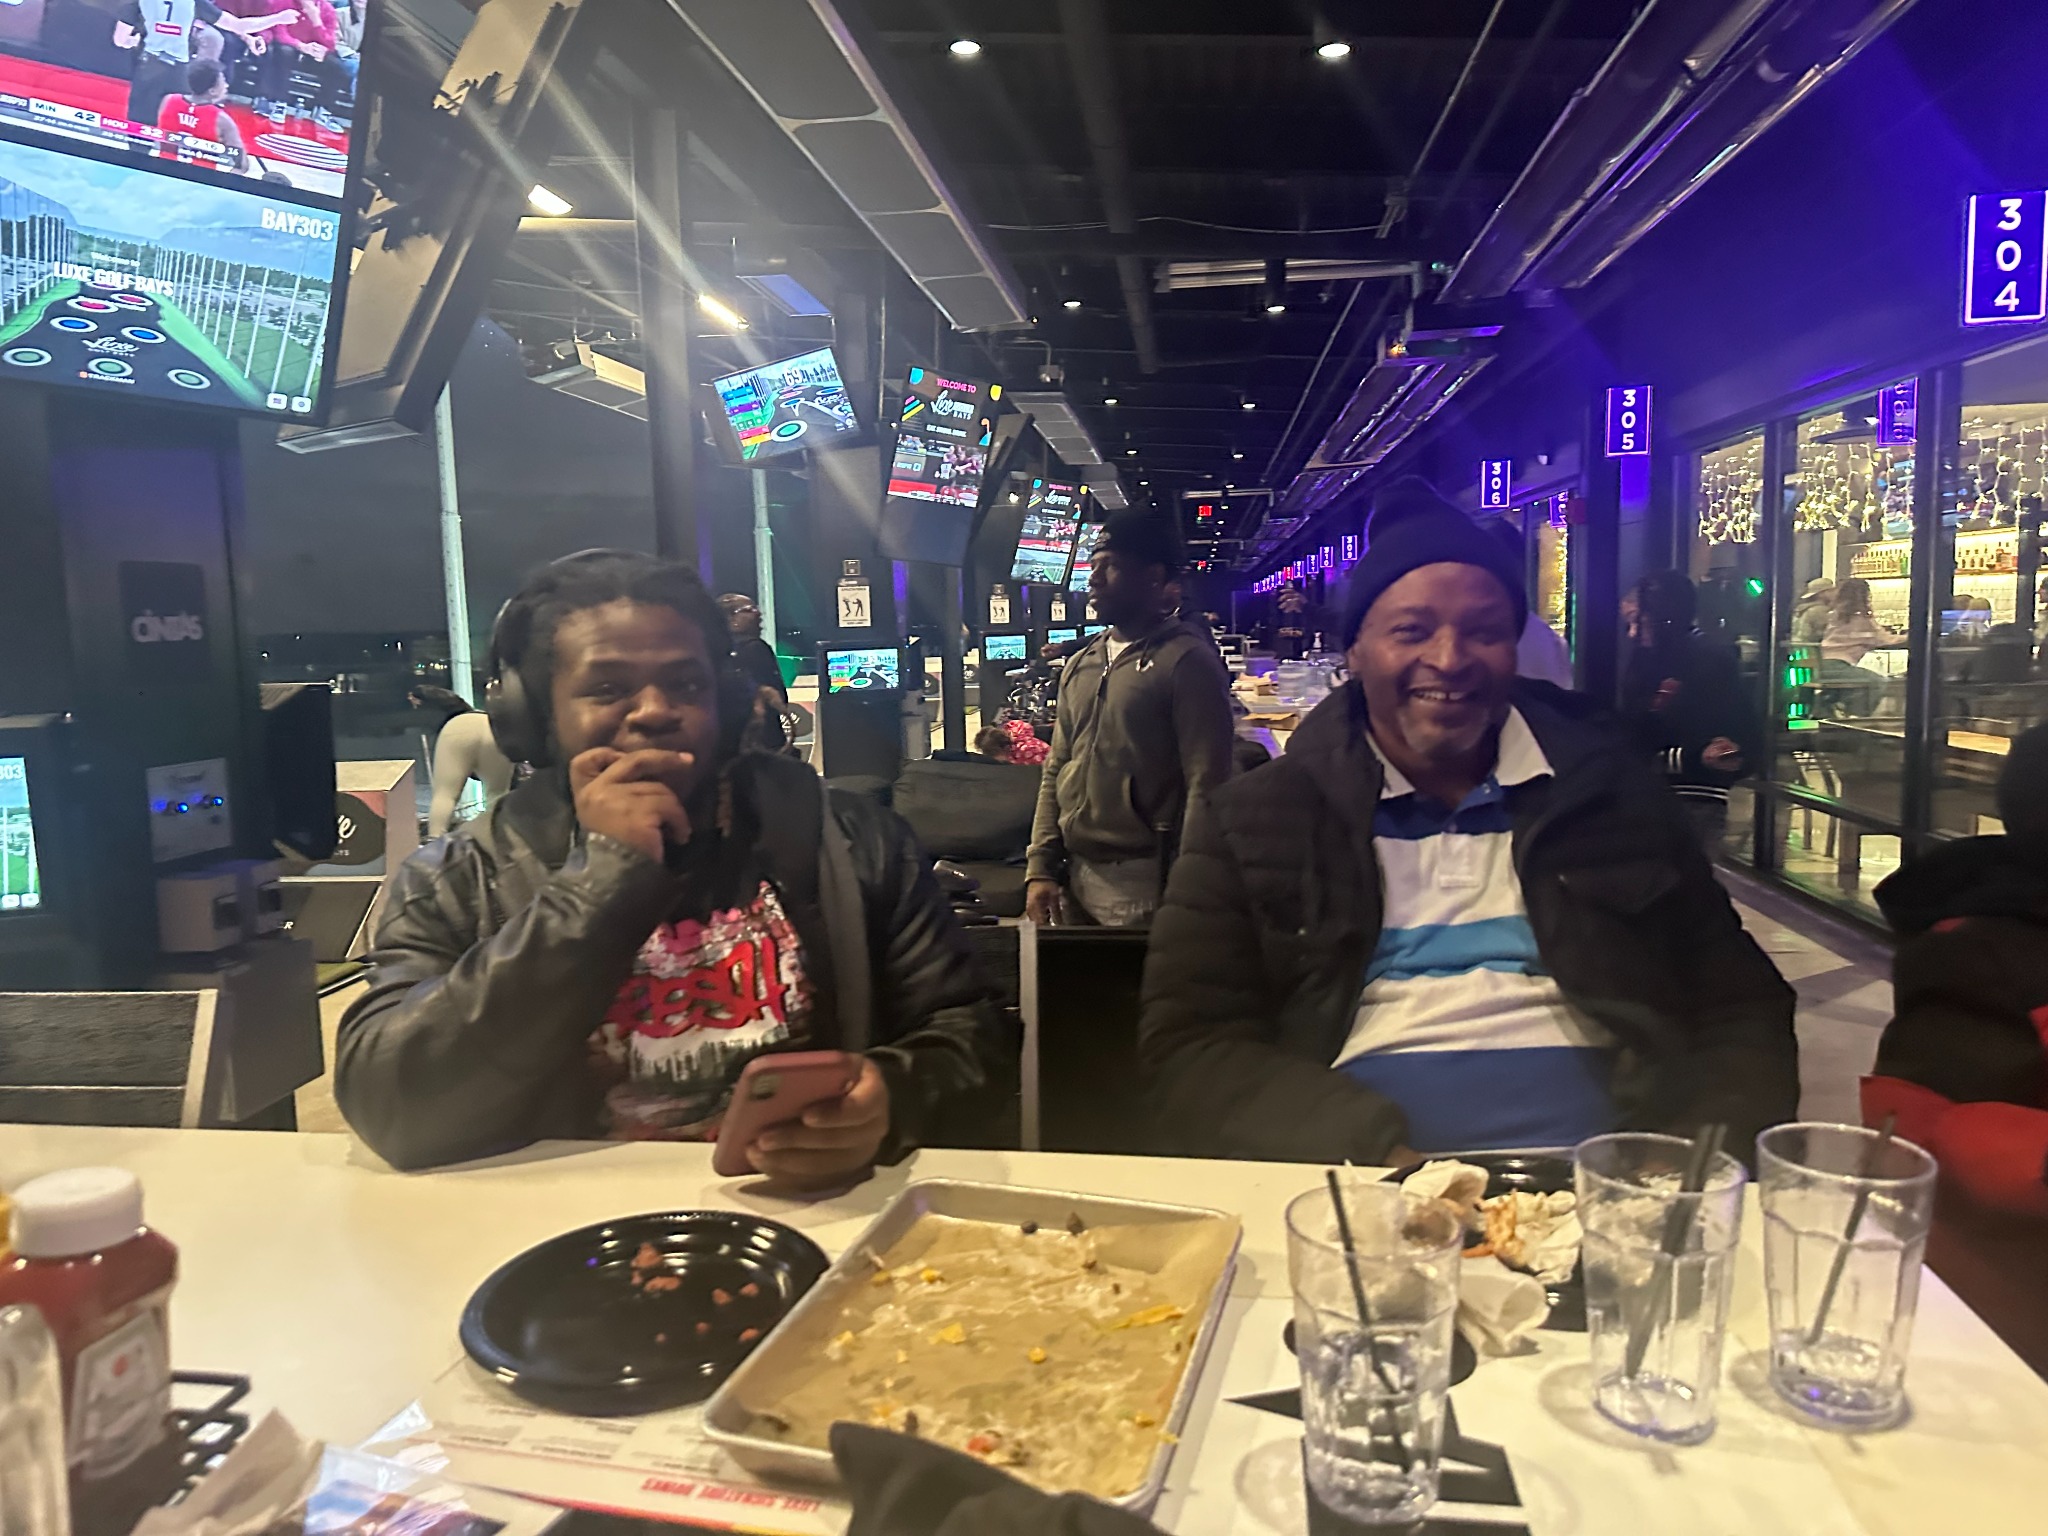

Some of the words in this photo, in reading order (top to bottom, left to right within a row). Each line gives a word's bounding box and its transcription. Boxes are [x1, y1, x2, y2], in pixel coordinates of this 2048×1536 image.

[35, 102, 56, 112] MIN
[74, 111, 96, 122] 42
[102, 118, 129, 129] HOU
[140, 125, 163, 138] 32
[178, 113, 199, 128] TATE
[1994, 198, 2022, 312] 304
[53, 261, 94, 282] LUXE
[95, 269, 133, 288] GOLF
[134, 275, 174, 296] BAYS
[81, 336, 140, 353] Luxe
[937, 377, 967, 391] WELCOME
[967, 385, 977, 394] TO
[1621, 389, 1636, 450] 305
[1491, 462, 1501, 504] 306
